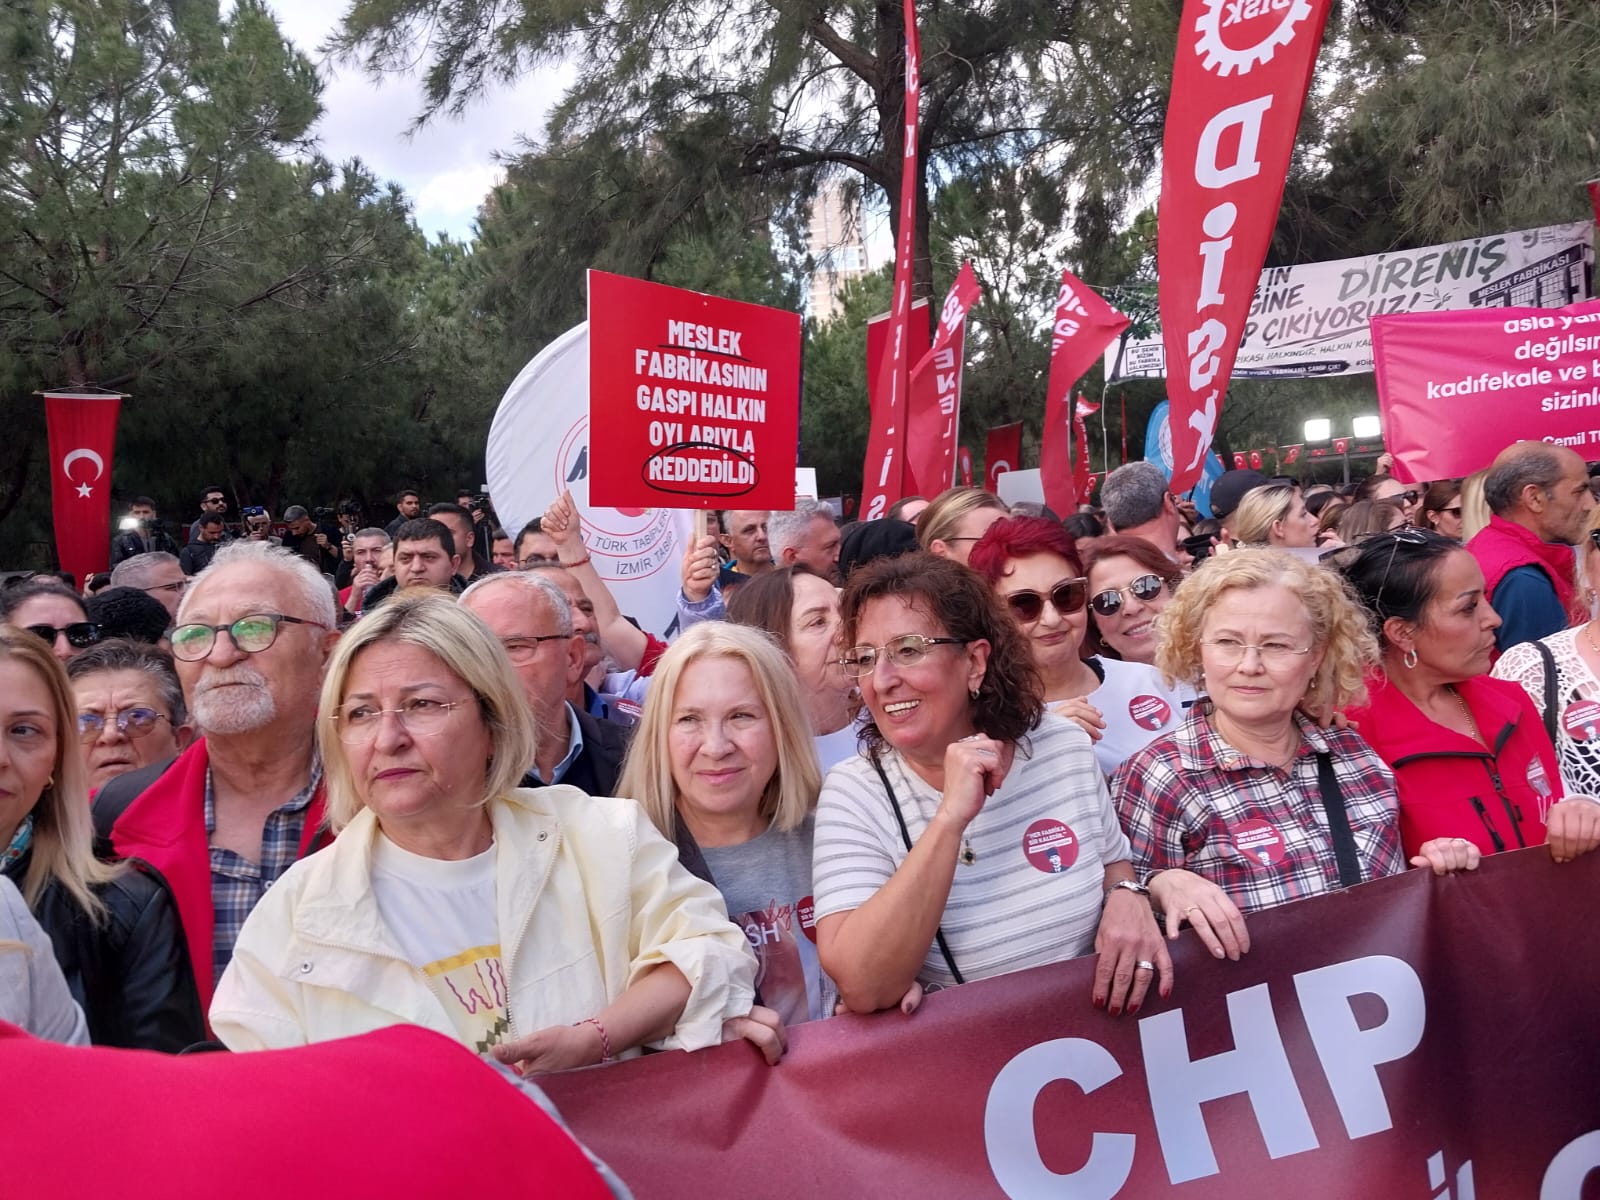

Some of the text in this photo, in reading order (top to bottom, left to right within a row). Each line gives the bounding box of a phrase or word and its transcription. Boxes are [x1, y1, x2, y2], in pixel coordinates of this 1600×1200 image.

[1337, 238, 1506, 302] DİRENİŞ
[1478, 254, 1570, 298] MESLEK FABRİKASI
[668, 319, 742, 356] MESLEK
[1503, 316, 1555, 334] asla
[635, 348, 768, 392] FABRİKASININ
[1558, 365, 1587, 382] ve
[636, 384, 766, 423] GASPI HALKIN
[649, 420, 755, 454] OYLARIYLA
[649, 453, 755, 485] REDDEDİLDİ
[595, 536, 628, 552] TÜRK
[616, 557, 653, 575] İZMİR
[984, 954, 1427, 1200] CHP
